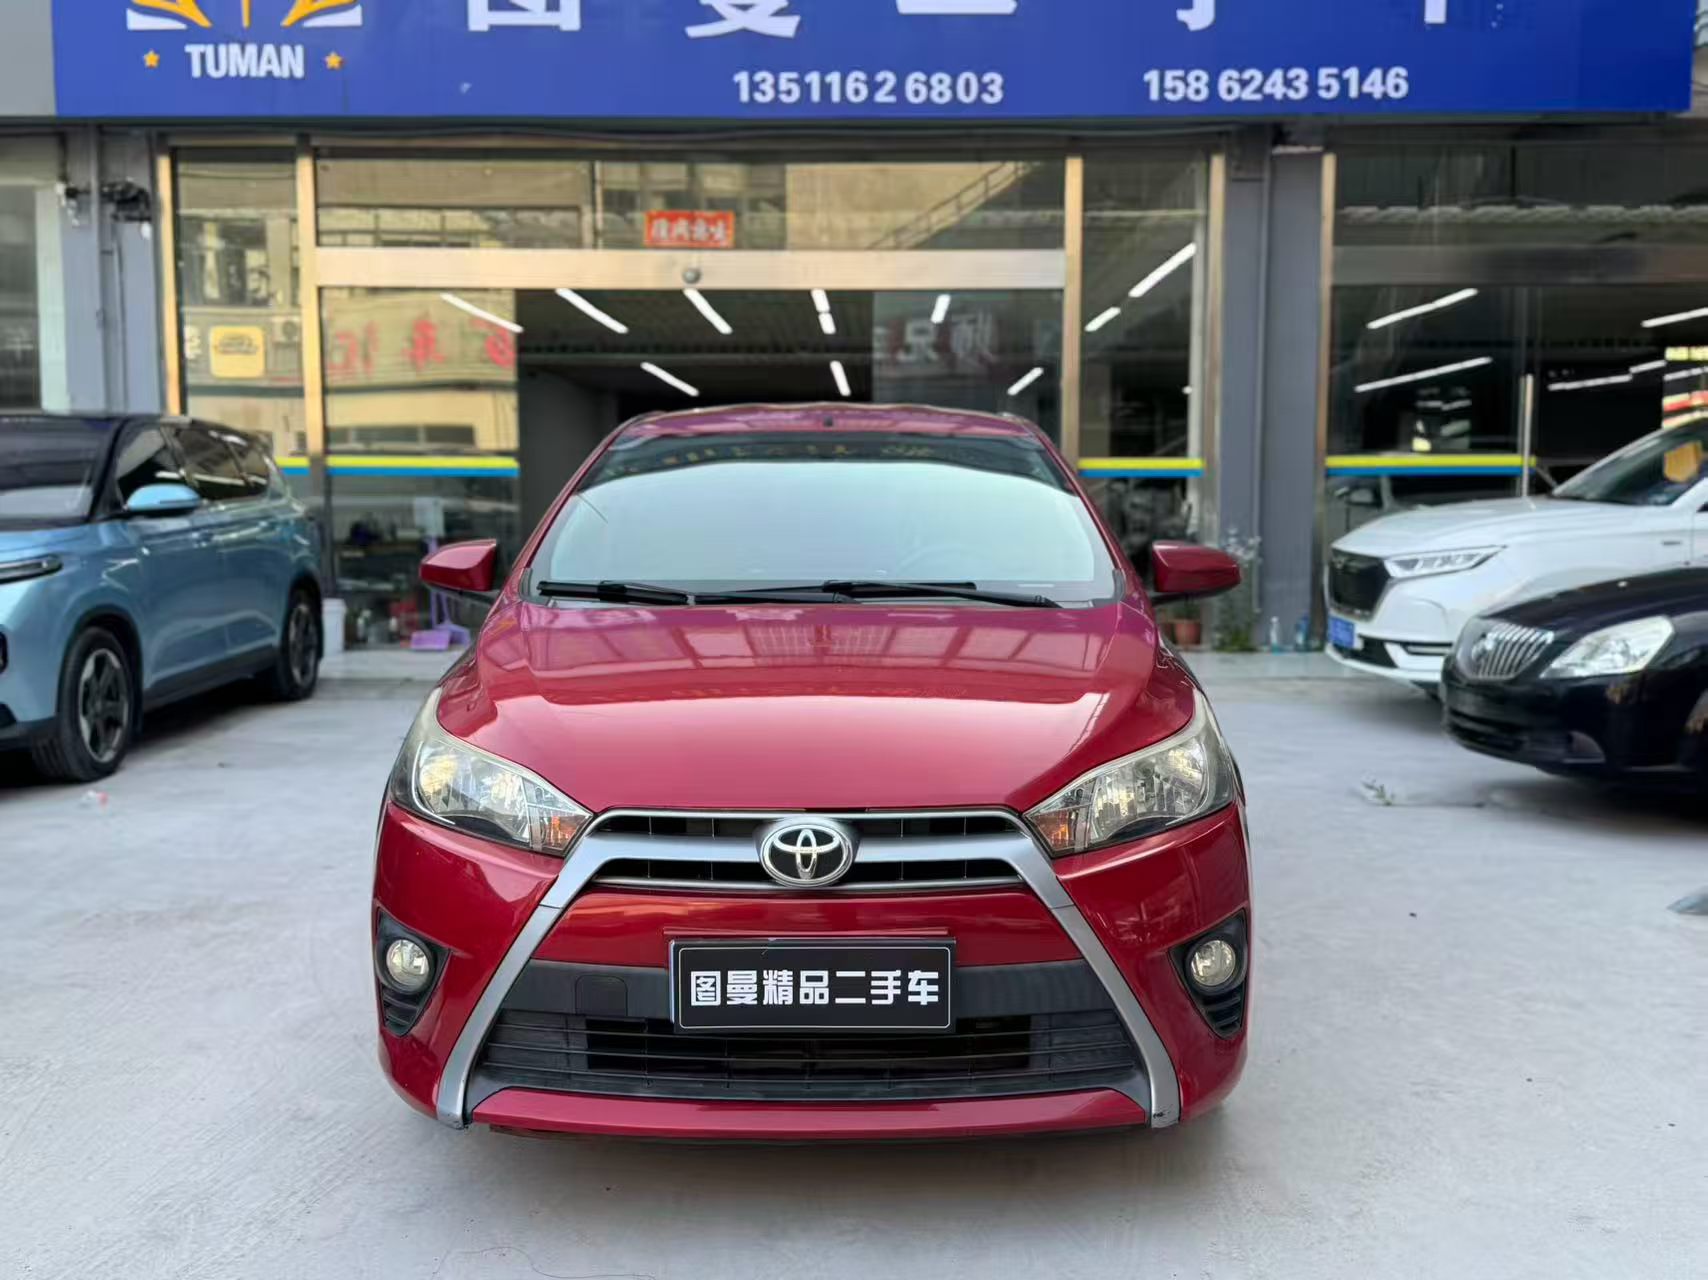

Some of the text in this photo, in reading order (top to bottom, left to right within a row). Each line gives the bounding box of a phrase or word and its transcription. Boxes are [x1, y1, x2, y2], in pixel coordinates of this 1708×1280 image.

[185, 44, 305, 78] TUMAN
[690, 969, 940, 1006] 图曼精品二手车
